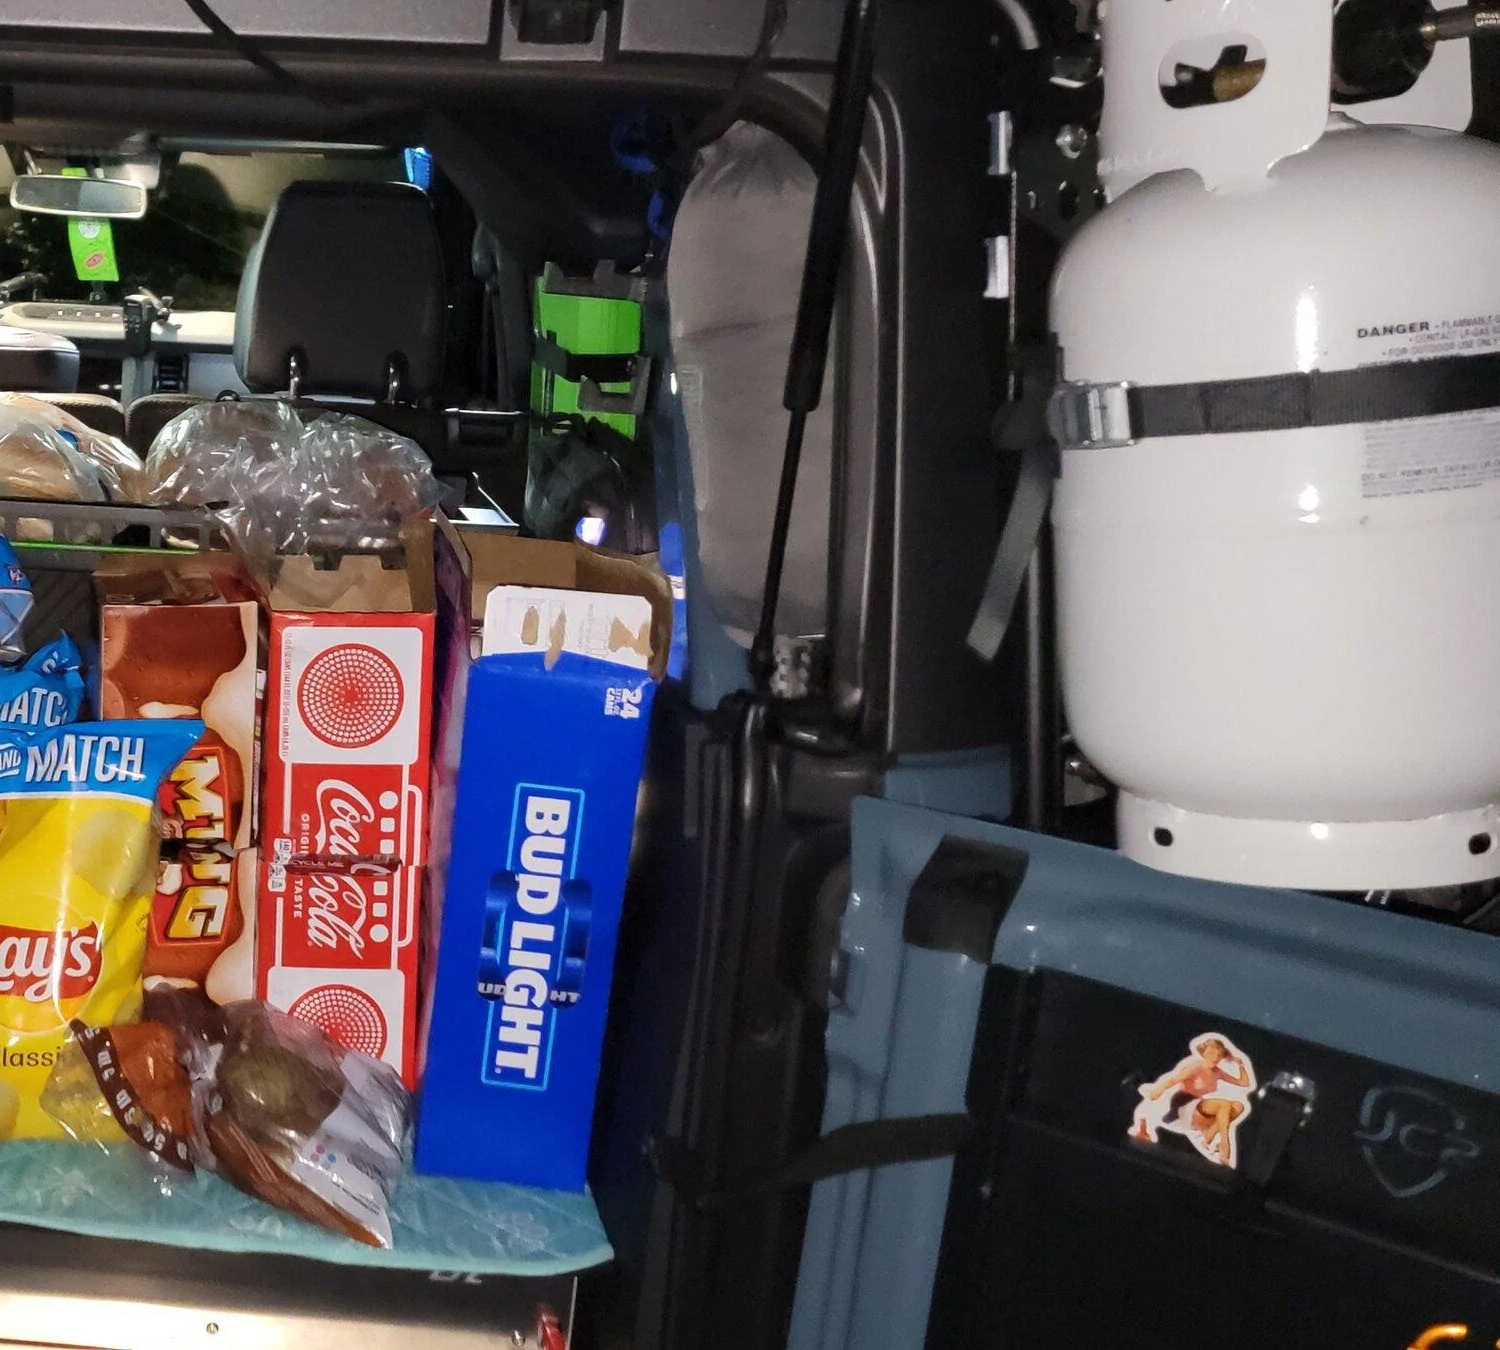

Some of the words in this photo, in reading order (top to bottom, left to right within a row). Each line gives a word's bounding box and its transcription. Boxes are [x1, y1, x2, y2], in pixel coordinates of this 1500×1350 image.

[1357, 321, 1430, 338] DANGER
[604, 687, 616, 716] CANS
[620, 688, 642, 719] 24
[25, 733, 147, 783] MATCH
[308, 779, 376, 960] CocaCola
[515, 796, 571, 915] BUD
[293, 880, 304, 919] TASTE
[495, 921, 555, 1079] LIGHT
